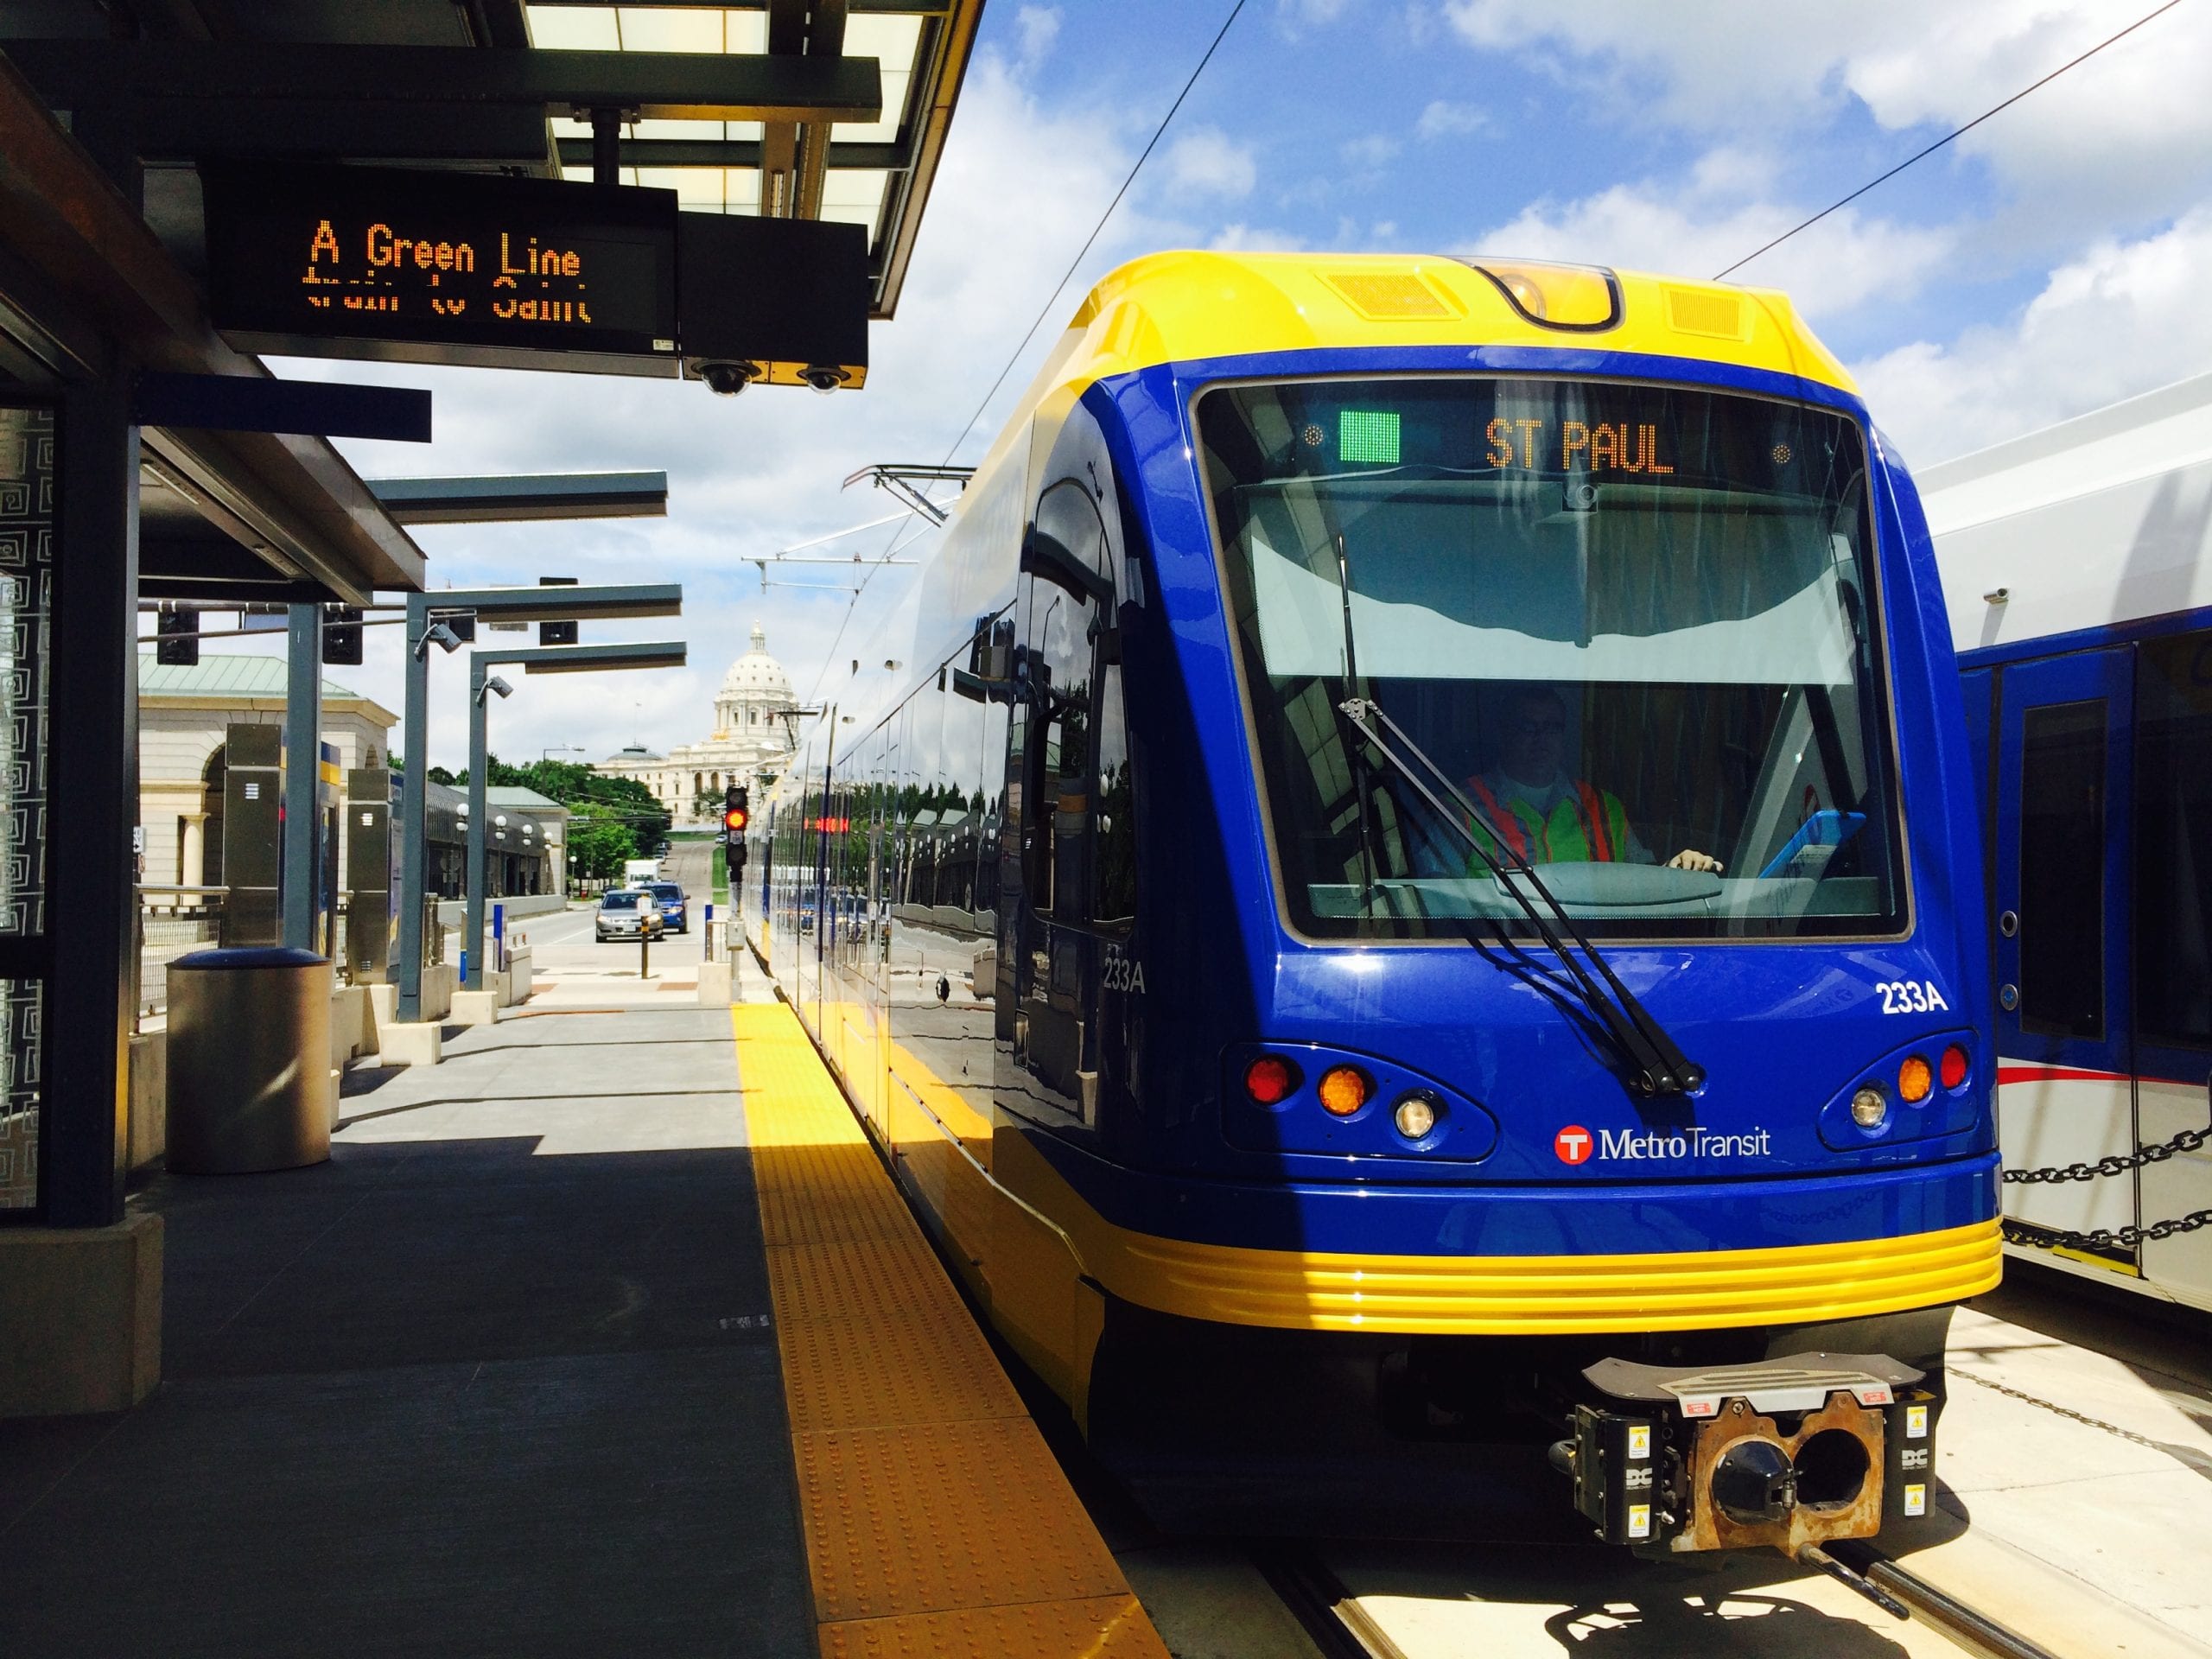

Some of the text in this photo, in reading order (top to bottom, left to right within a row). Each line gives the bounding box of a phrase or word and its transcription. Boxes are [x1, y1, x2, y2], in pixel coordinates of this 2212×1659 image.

[311, 219, 581, 276] A Green Line
[1486, 418, 1675, 474] ST PAUL
[1103, 957, 1146, 995] 233A
[1875, 981, 1949, 1014] 233A
